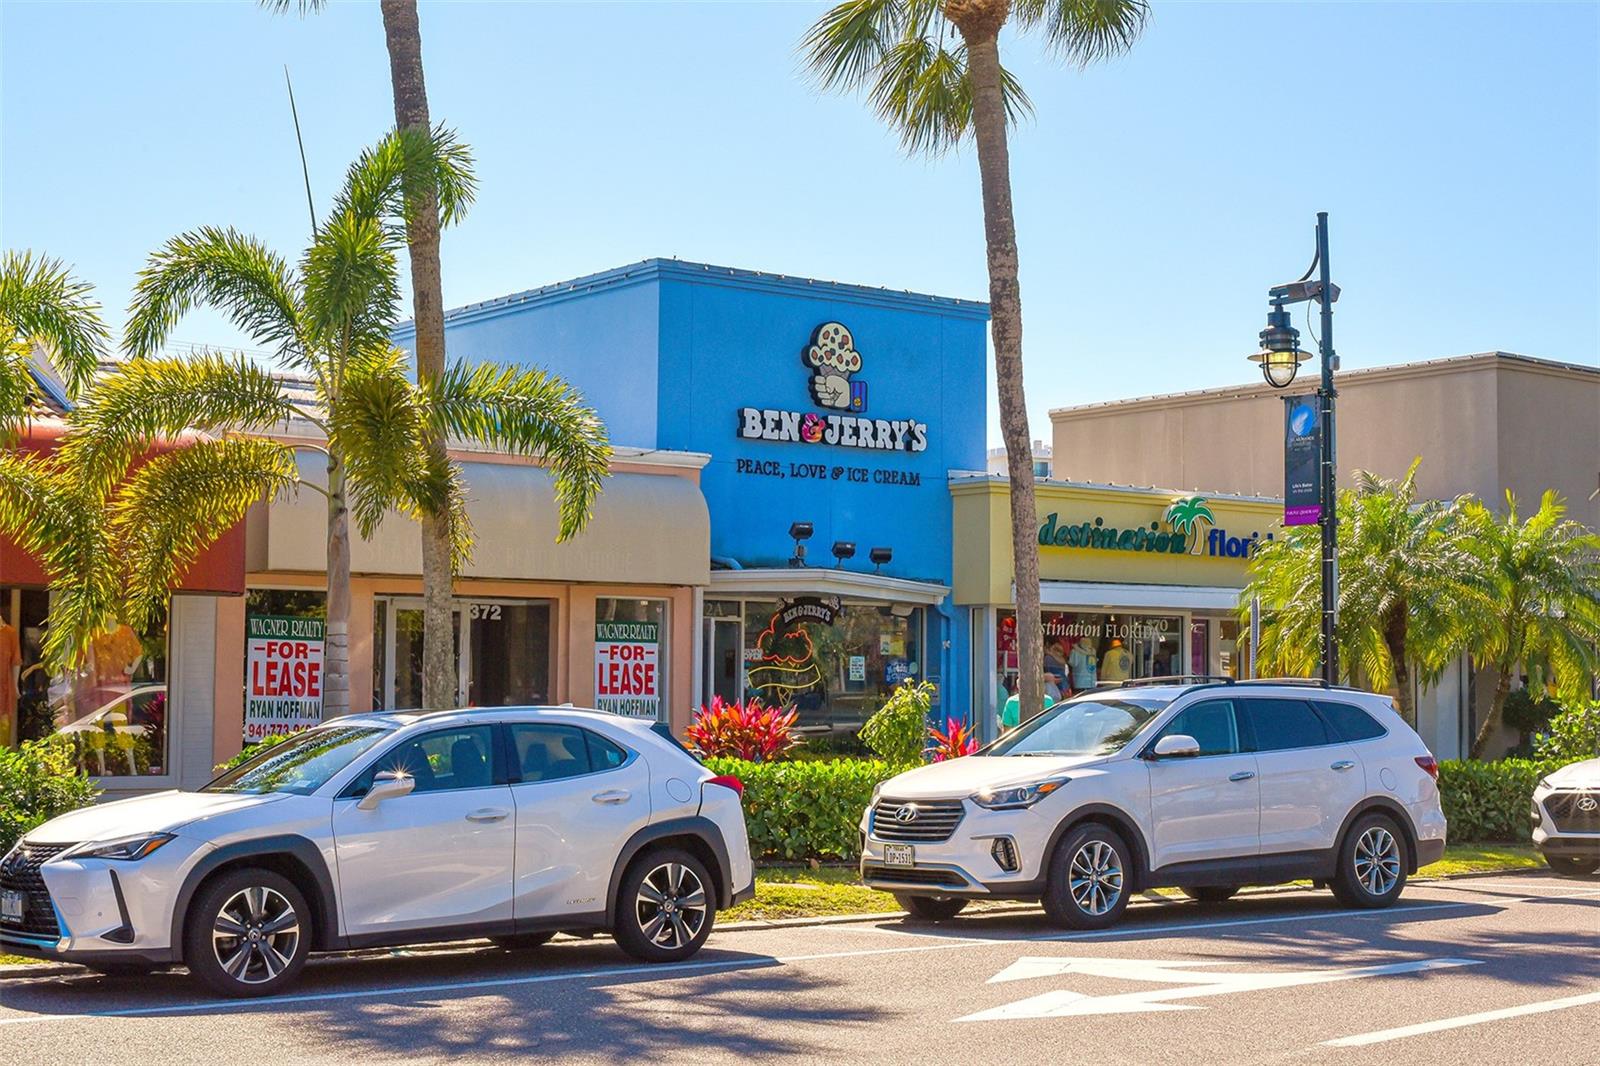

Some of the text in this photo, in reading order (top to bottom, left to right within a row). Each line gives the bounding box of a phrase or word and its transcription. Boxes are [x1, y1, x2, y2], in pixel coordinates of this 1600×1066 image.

[736, 458, 784, 478] PEACE,
[790, 463, 827, 479] LOVE
[847, 467, 868, 482] ICE
[873, 470, 921, 486] CREAM
[1038, 512, 1186, 554] destination
[470, 604, 501, 620] 372
[251, 618, 323, 637] WAGNER REALTY
[597, 623, 657, 640] WAGNER REALTY
[1041, 617, 1101, 637] stination
[252, 661, 320, 697] LEASE
[598, 662, 655, 696] LEASE
[250, 700, 320, 720] RYAN HOFFMAN
[598, 699, 656, 716] RYAN HOFFMAN
